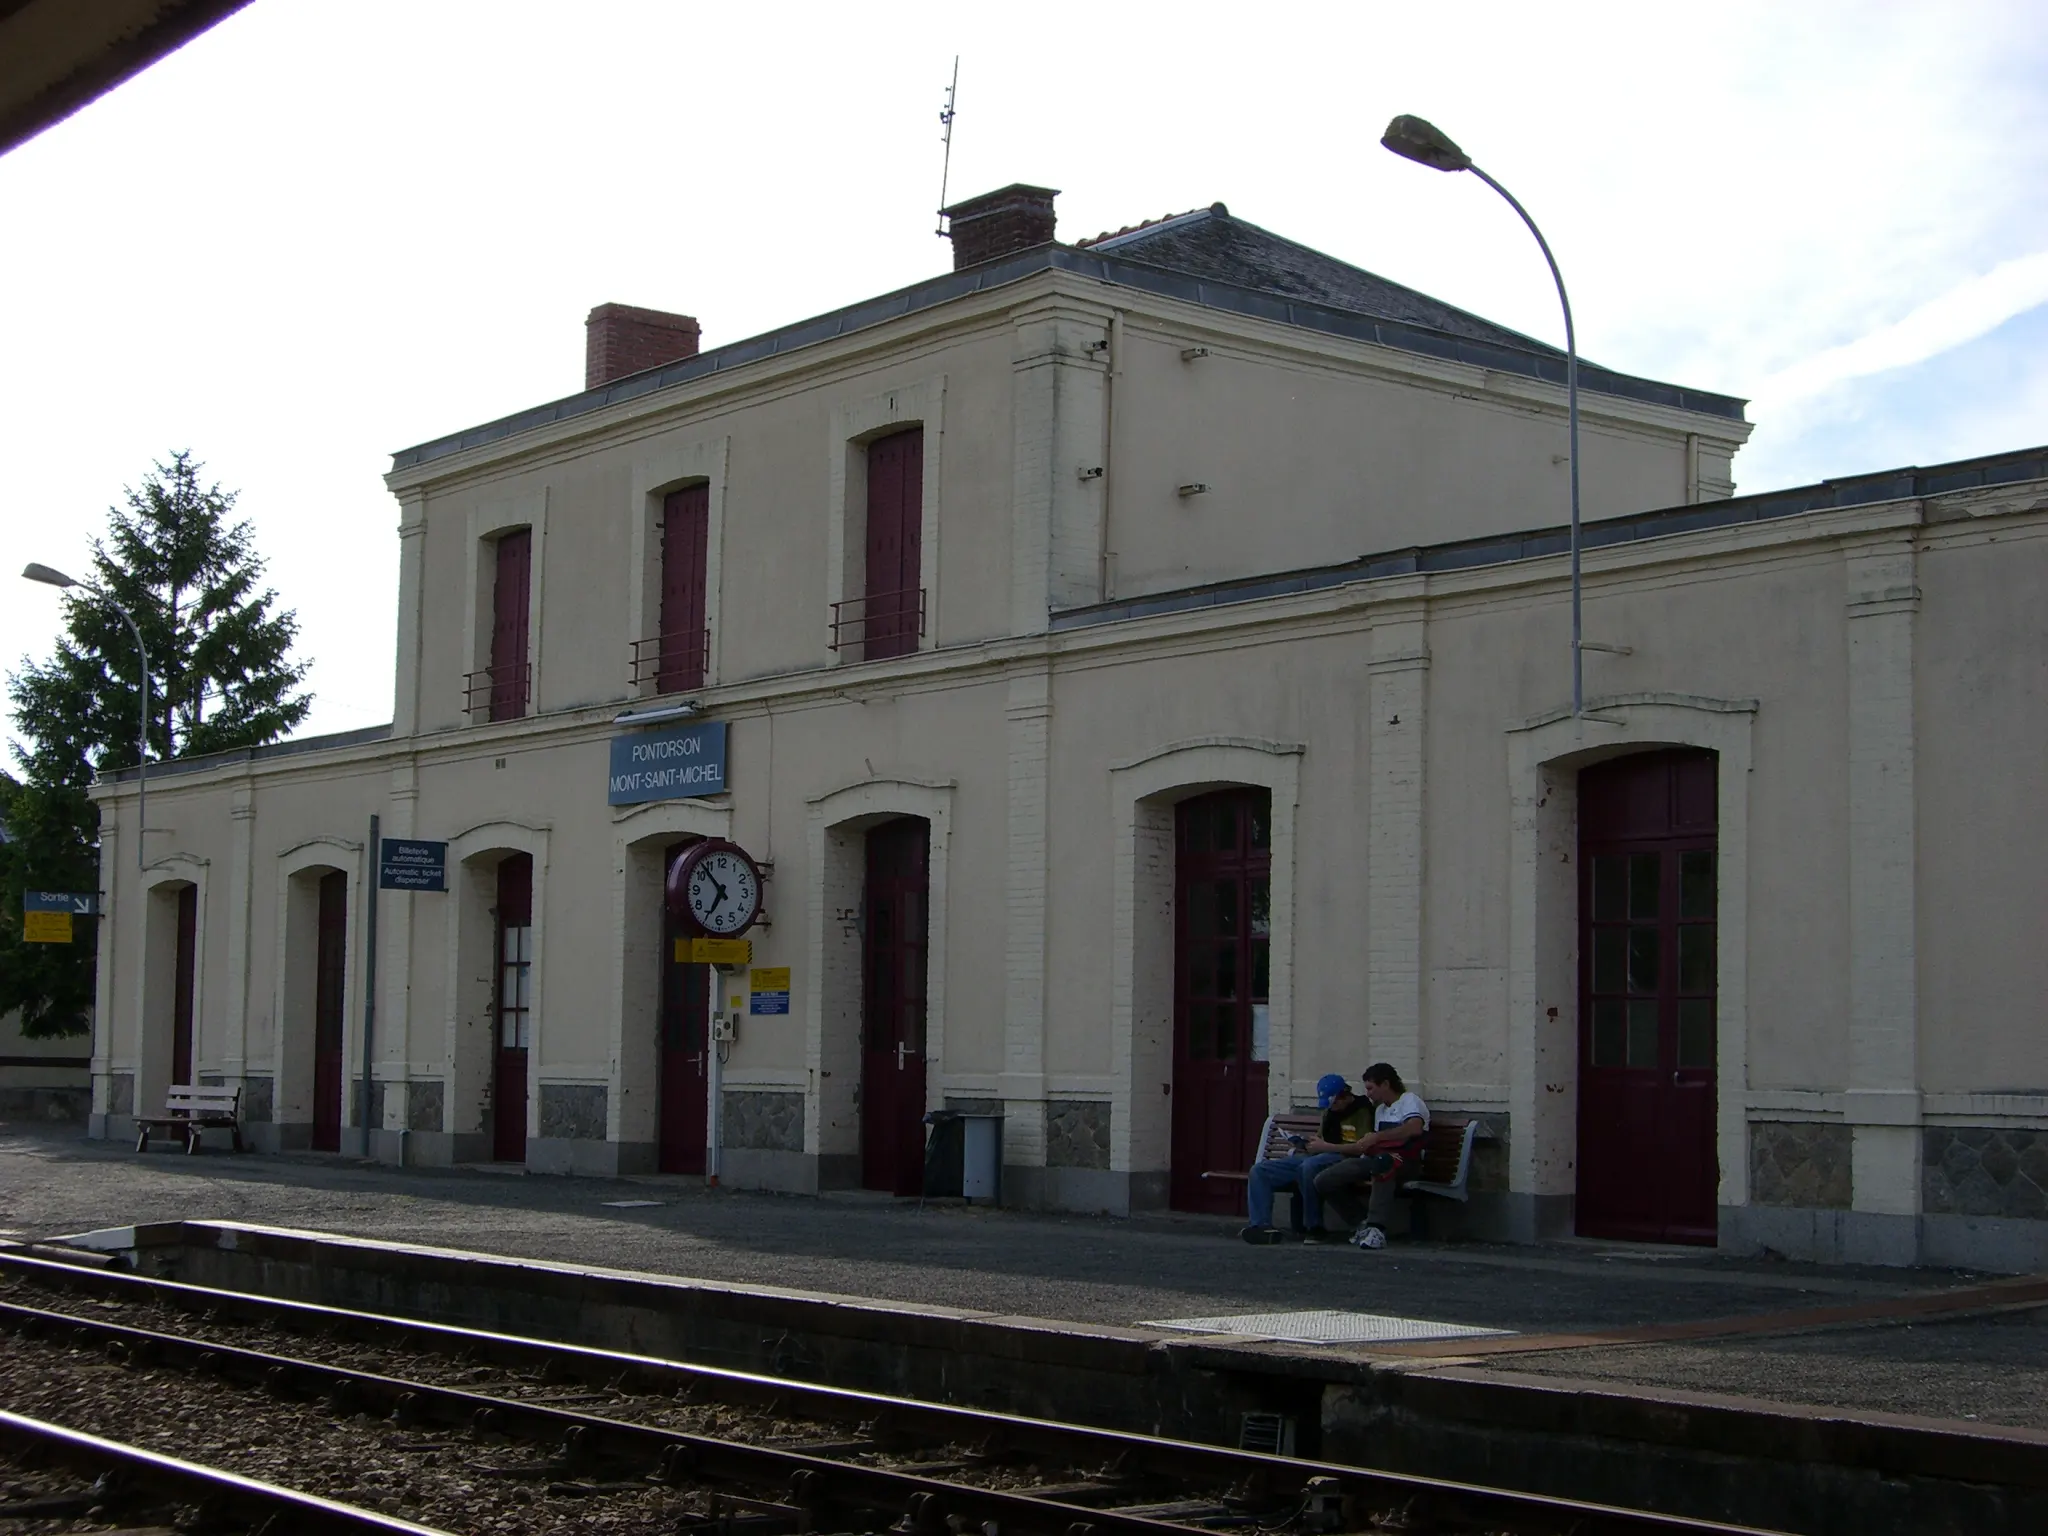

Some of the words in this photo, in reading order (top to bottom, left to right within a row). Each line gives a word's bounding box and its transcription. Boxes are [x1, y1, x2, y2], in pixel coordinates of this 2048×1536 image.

[632, 736, 700, 762] PONTORSON
[610, 764, 721, 792] MONT-SAINT-MICHEL
[392, 856, 434, 864] automatique
[717, 857, 727, 869] 12
[706, 861, 714, 872] 11
[732, 863, 736, 872] 1
[384, 868, 419, 876] Automatic
[422, 869, 442, 877] ticket
[696, 871, 706, 882] 10
[395, 876, 430, 884] dispenser
[738, 873, 746, 885] 2
[692, 884, 701, 896] 9
[741, 888, 749, 899] 3
[40, 892, 69, 902] Sortie
[695, 899, 703, 910] 8
[737, 902, 745, 913] 4
[704, 910, 712, 921] 7
[715, 915, 724, 926] 6
[728, 912, 736, 923] 5
